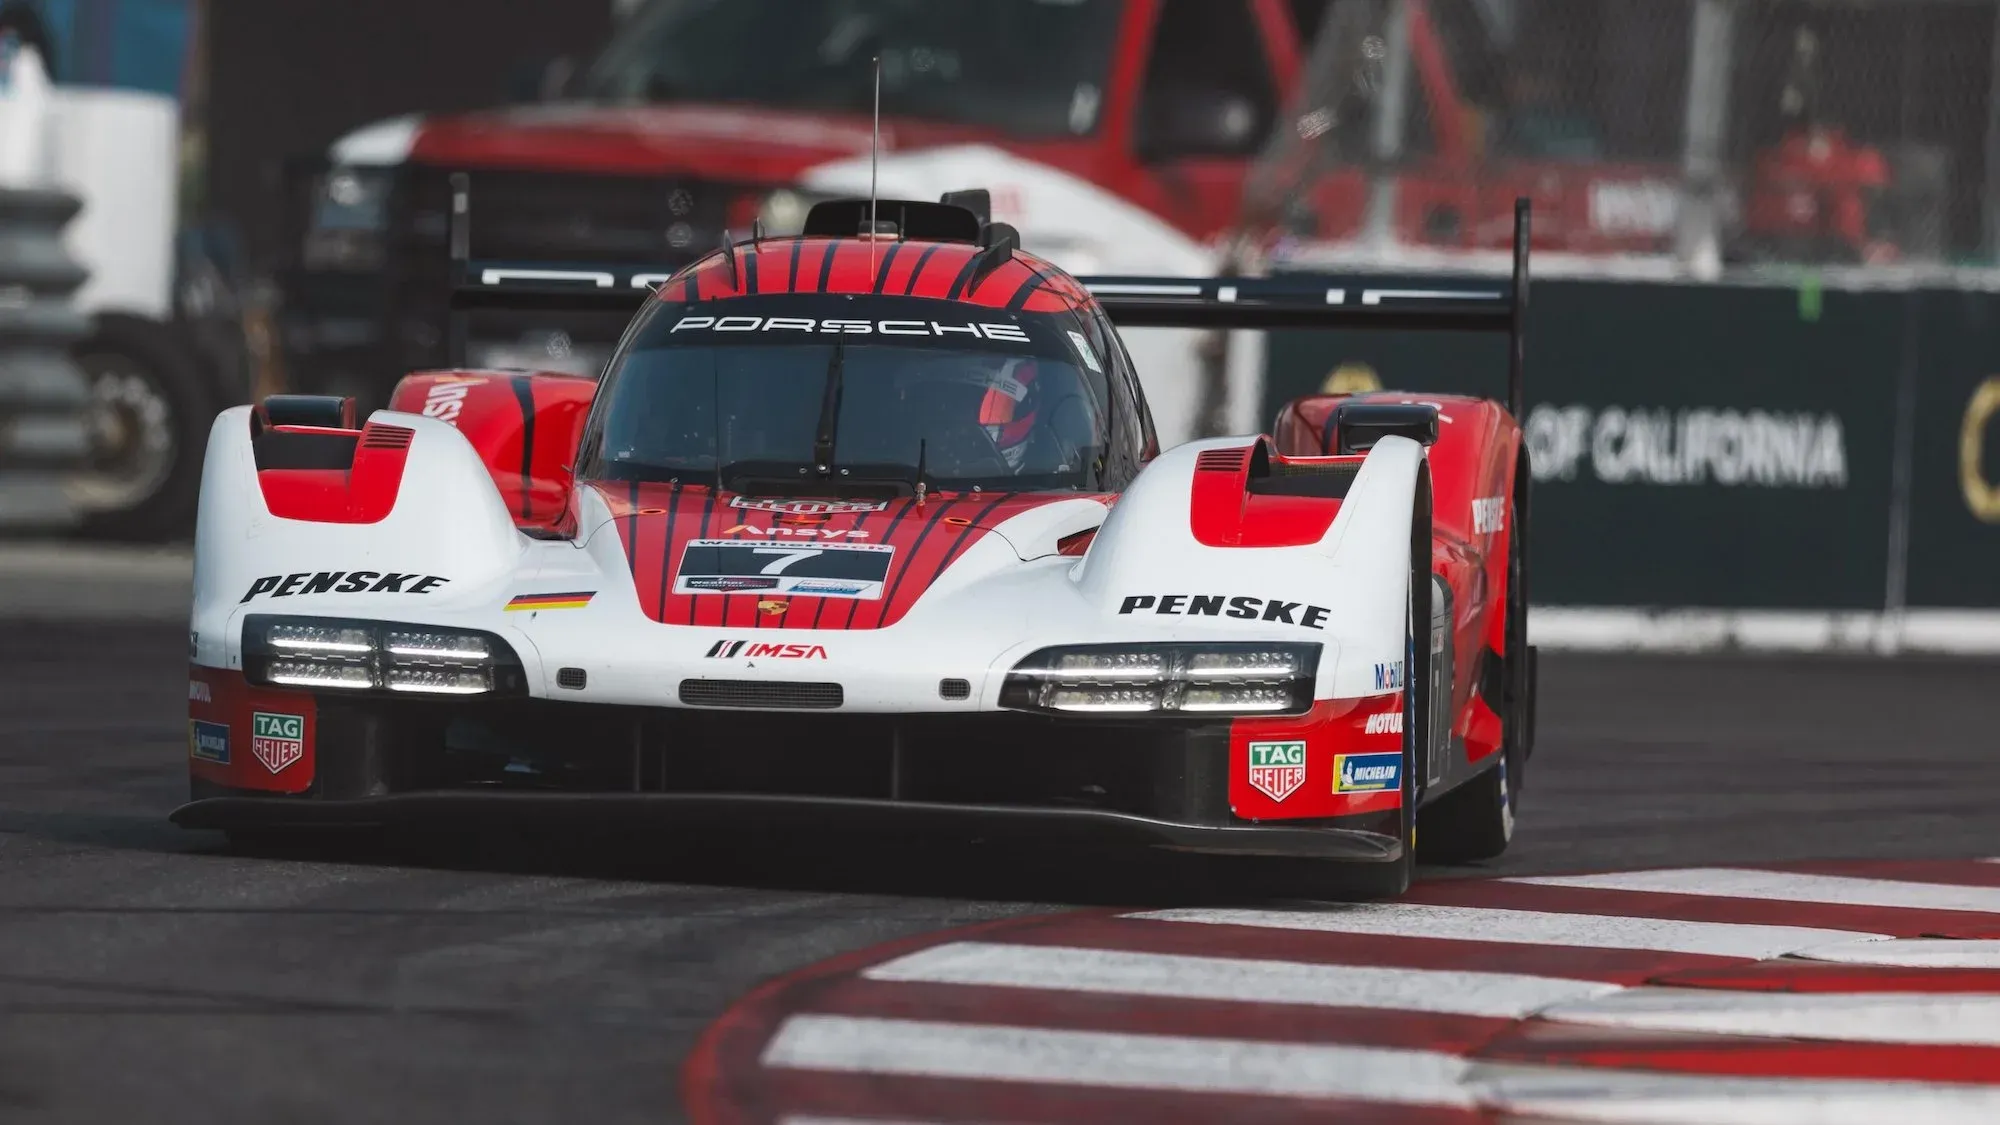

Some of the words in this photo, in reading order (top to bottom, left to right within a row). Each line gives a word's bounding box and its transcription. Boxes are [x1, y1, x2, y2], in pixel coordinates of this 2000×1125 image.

[670, 316, 1031, 342] PORSCHE
[1594, 405, 1848, 488] CALIFORNIA
[723, 525, 870, 538] Ansys
[752, 547, 824, 575] 7
[239, 571, 450, 604] PENSKE
[1118, 594, 1331, 630] PENSKE
[744, 643, 828, 660] IMSA
[257, 717, 298, 738] TAG
[255, 739, 298, 769] HEUER
[1255, 747, 1300, 764] TAG
[1253, 769, 1301, 797] HEUER
[1354, 766, 1396, 780] MICHELIN
